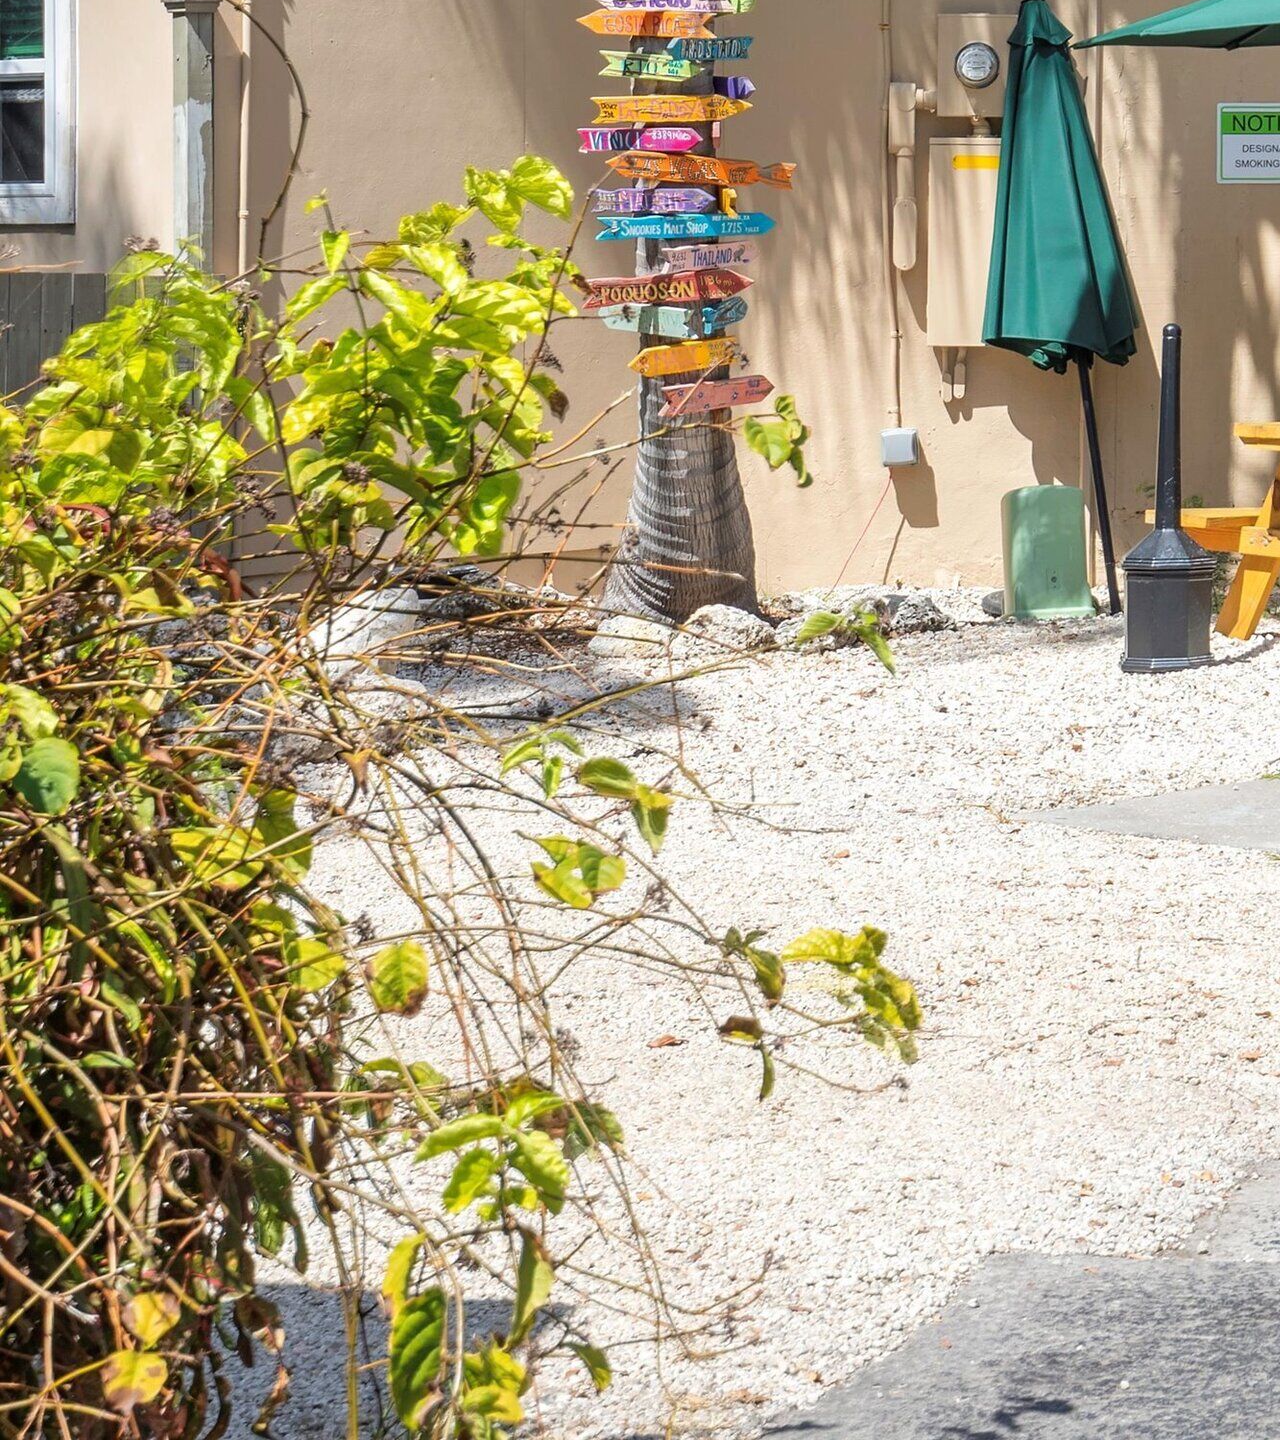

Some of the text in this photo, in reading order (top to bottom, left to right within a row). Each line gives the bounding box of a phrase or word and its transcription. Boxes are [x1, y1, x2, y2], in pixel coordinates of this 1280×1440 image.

[604, 15, 647, 33] COSTA
[1235, 159, 1280, 168] SMOKING
[620, 220, 709, 237] SNOOKIES MALT SHOP
[691, 247, 733, 268] THAILAND
[601, 280, 695, 304] POQUOSON
